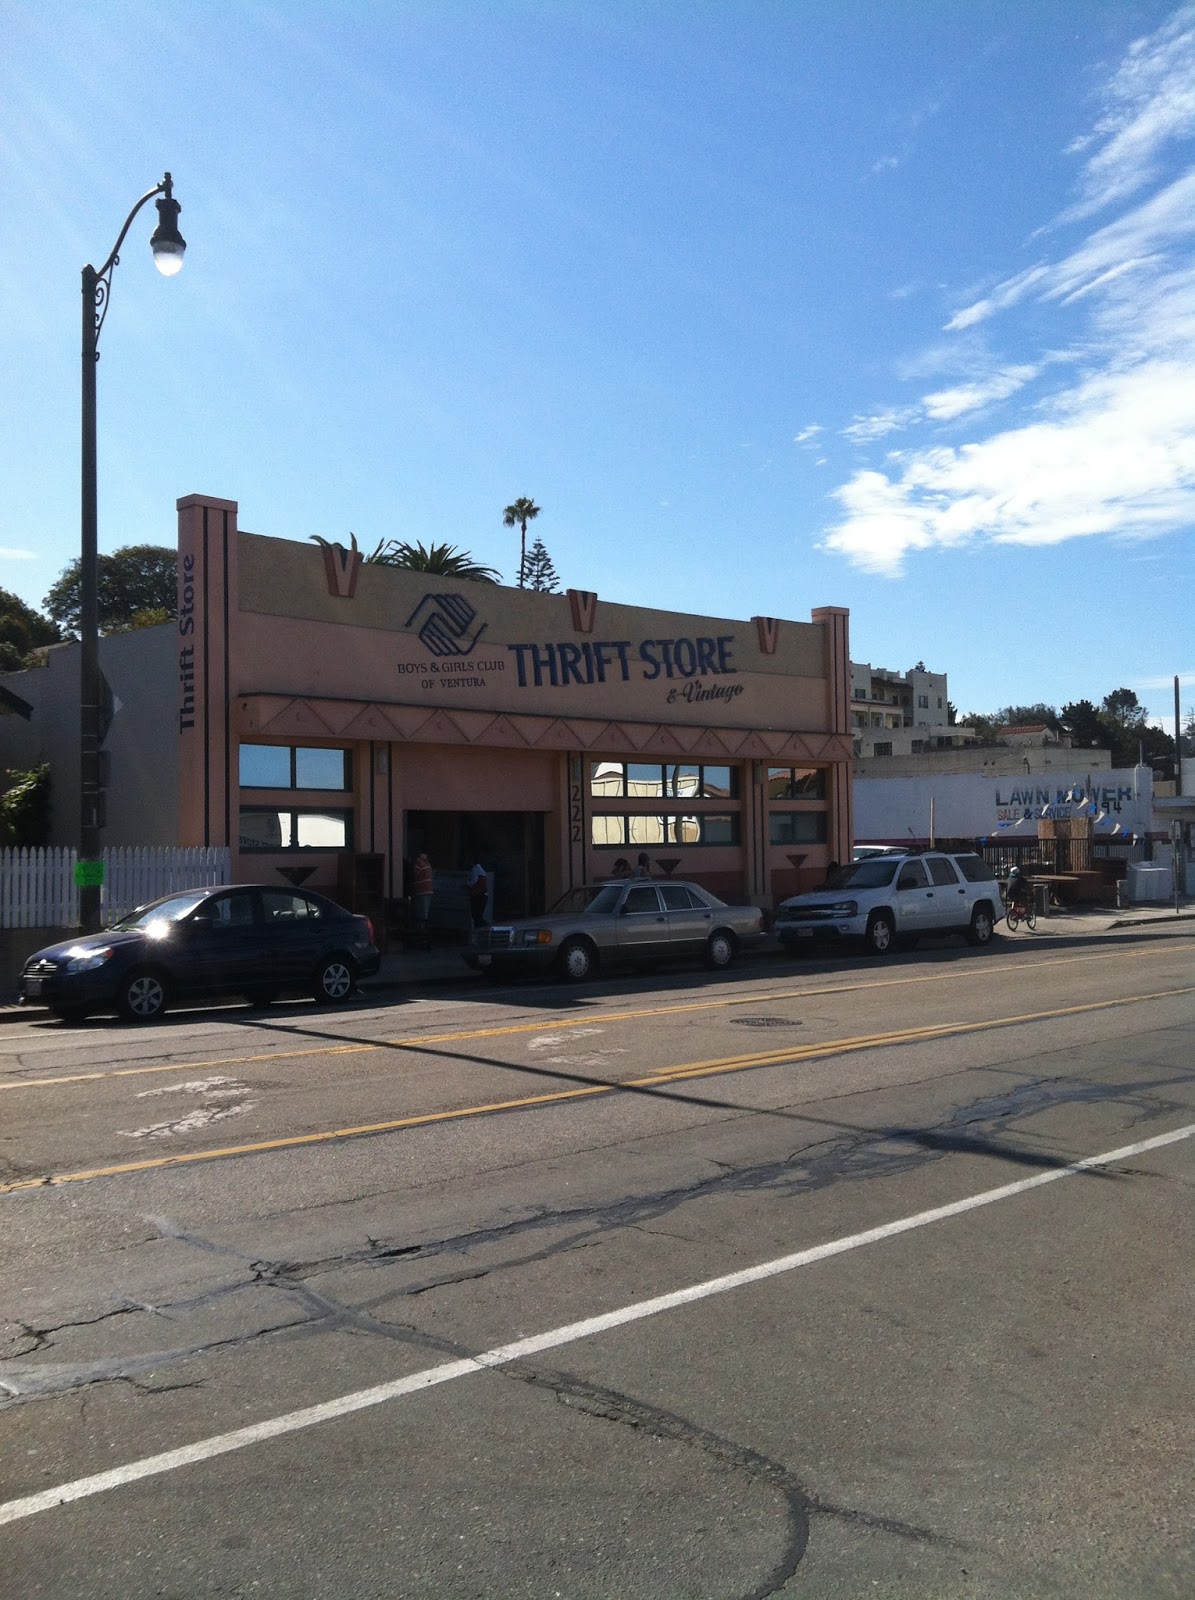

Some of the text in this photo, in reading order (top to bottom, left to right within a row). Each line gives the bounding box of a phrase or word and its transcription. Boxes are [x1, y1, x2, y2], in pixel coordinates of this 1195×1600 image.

[179, 553, 195, 735] Thrift Store
[397, 660, 505, 674] BOYS & GIRLS CLUB
[507, 635, 738, 688] THRIFT STORE
[421, 678, 486, 689] OF VENTURA
[682, 680, 744, 704] Vintage
[995, 785, 1050, 806] LAWN
[997, 808, 1020, 821] SALE
[1023, 808, 1032, 820] &
